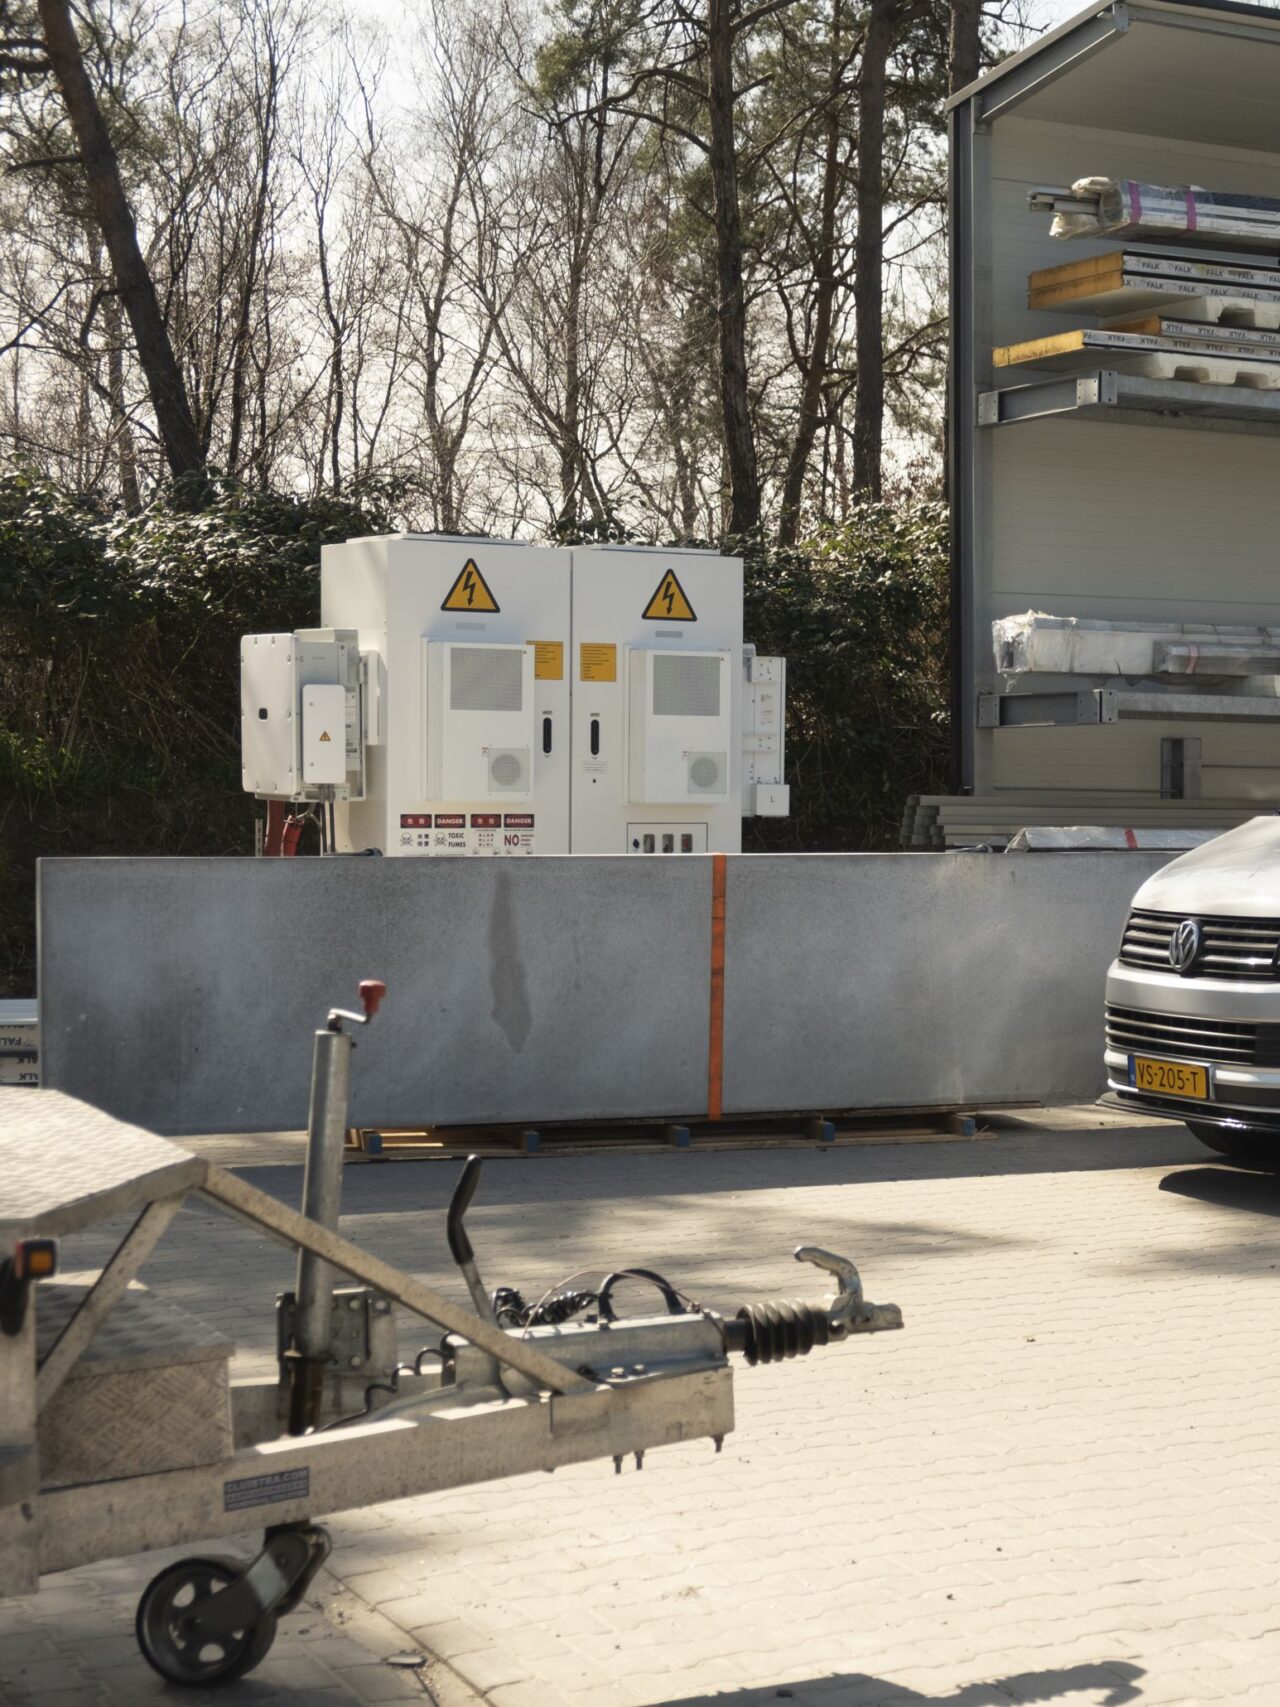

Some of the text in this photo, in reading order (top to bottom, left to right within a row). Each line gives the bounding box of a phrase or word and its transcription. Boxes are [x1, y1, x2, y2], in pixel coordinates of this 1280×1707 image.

[1142, 262, 1160, 270] FALK
[1174, 265, 1192, 273] FALK
[1206, 269, 1223, 277] FALK
[1238, 272, 1254, 280] FALK
[1146, 281, 1164, 289] FALK
[1179, 285, 1196, 293] FALK
[1211, 288, 1227, 296] FALK
[1165, 323, 1183, 332] FALK
[1197, 327, 1214, 336] FALK
[1228, 331, 1246, 339] FALK
[1259, 334, 1276, 342] FALK
[1140, 337, 1157, 345] FALK
[1172, 340, 1190, 348] FALK
[1205, 343, 1223, 351] FALK
[504, 834, 520, 846] NO
[0, 1037, 21, 1046] FAL
[1137, 1063, 1199, 1092] VS-205-T
